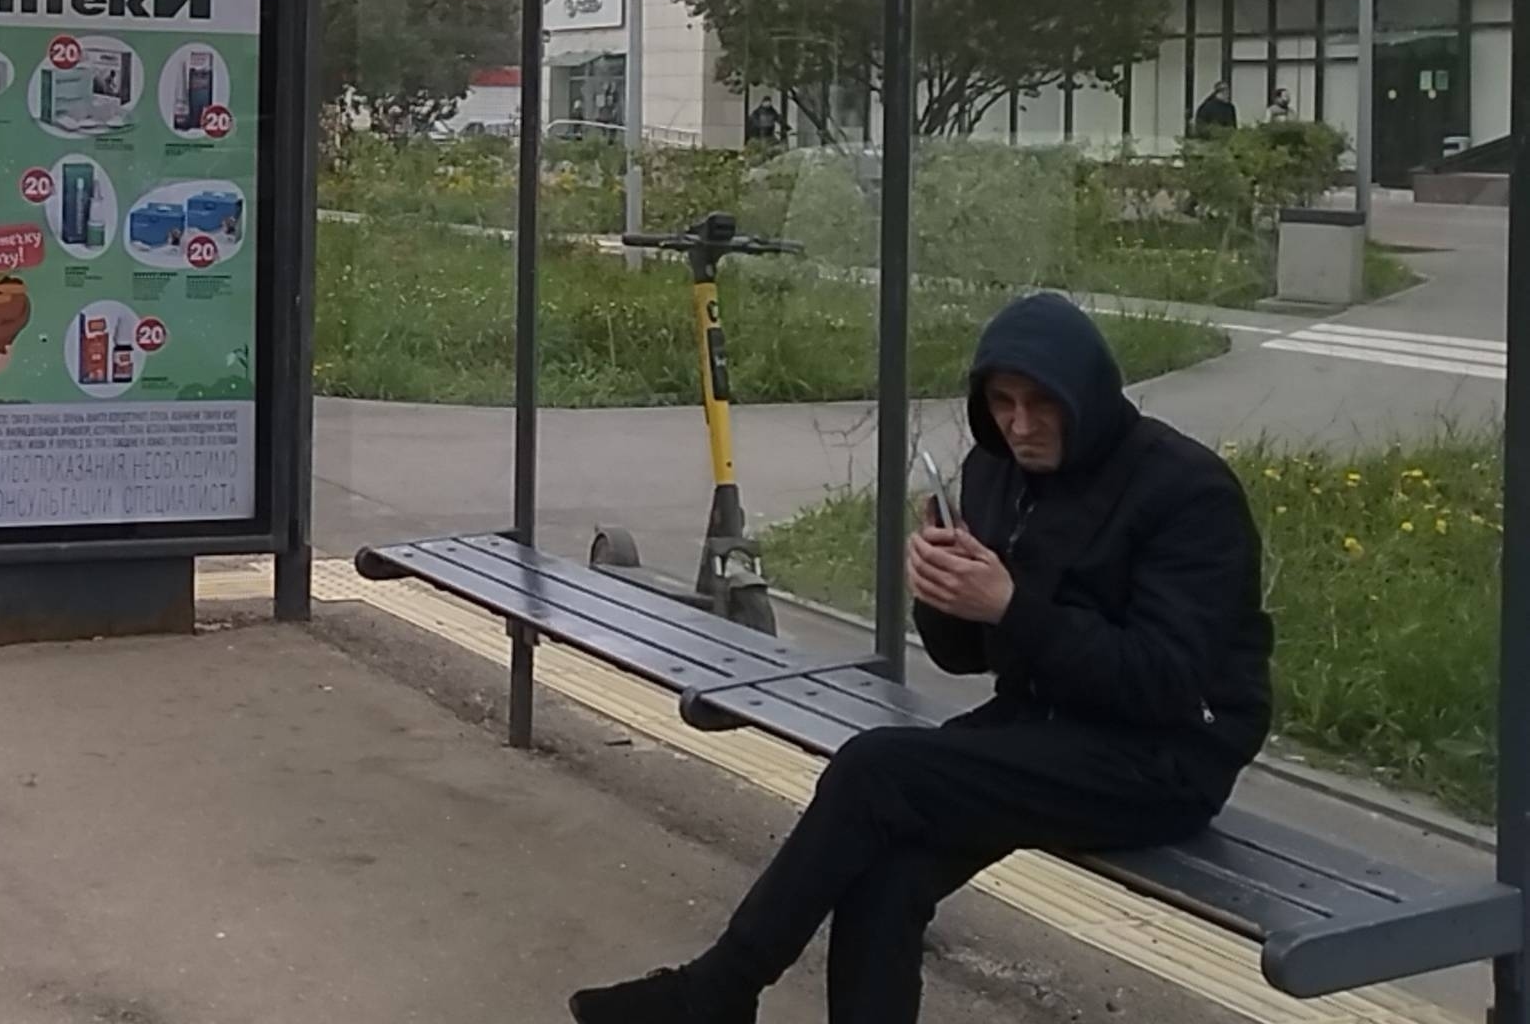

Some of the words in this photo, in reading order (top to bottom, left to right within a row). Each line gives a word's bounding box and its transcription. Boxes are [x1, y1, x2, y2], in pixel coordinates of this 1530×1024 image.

[53, 43, 78, 61] 20
[205, 113, 230, 130] 20
[25, 177, 50, 195] 20
[190, 243, 214, 260] 20
[139, 327, 163, 344] 20
[132, 450, 238, 481] НЕОБХОДИМО
[123, 482, 238, 515] СПЕЦИАЛИСТА
